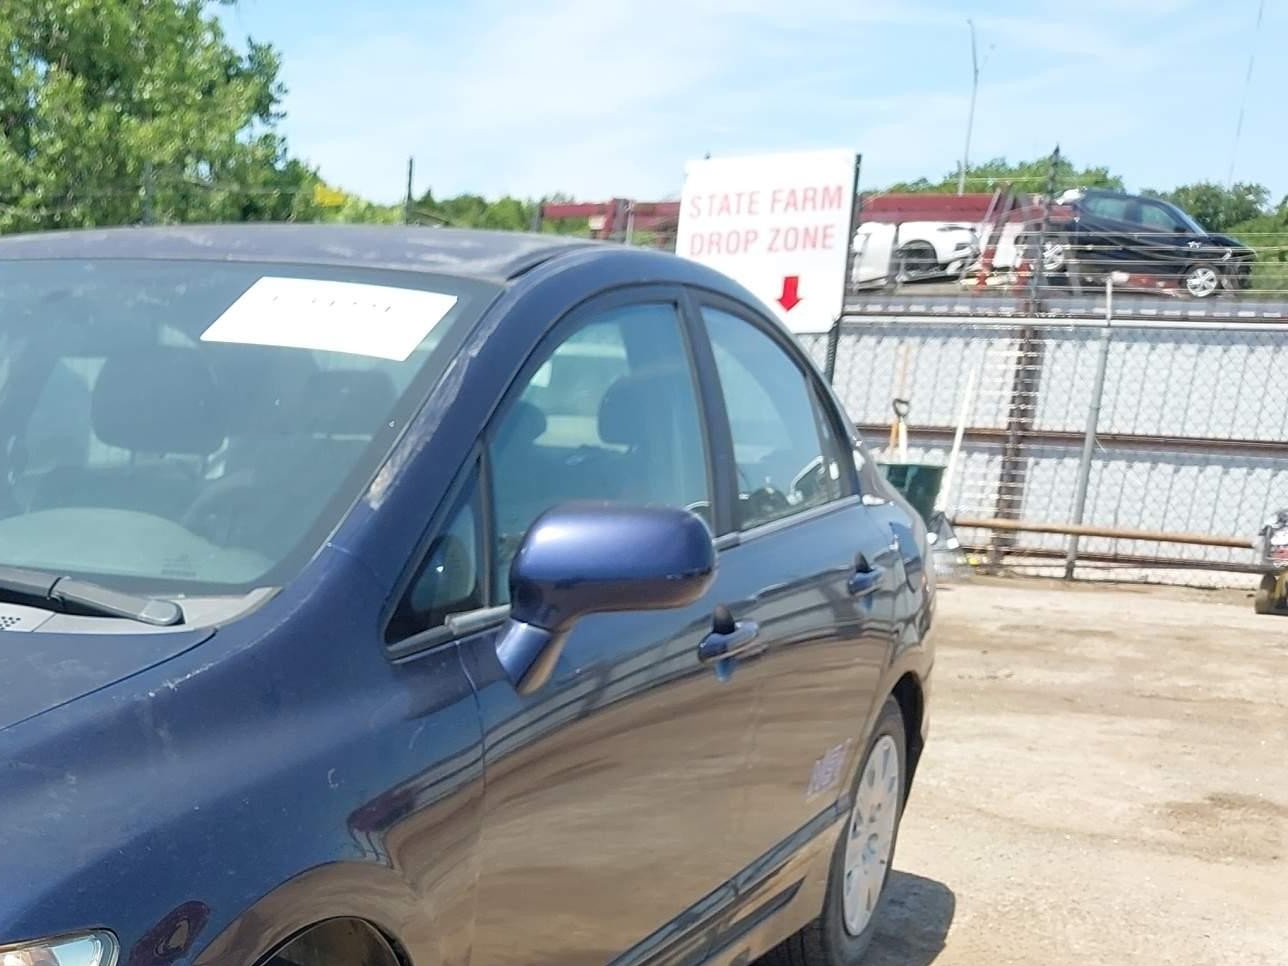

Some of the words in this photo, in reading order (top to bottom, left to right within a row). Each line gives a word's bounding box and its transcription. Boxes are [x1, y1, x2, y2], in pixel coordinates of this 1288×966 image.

[689, 191, 761, 220] STATE
[769, 184, 844, 214] FARM
[689, 230, 758, 256] DROP
[767, 223, 836, 253] ZONE
